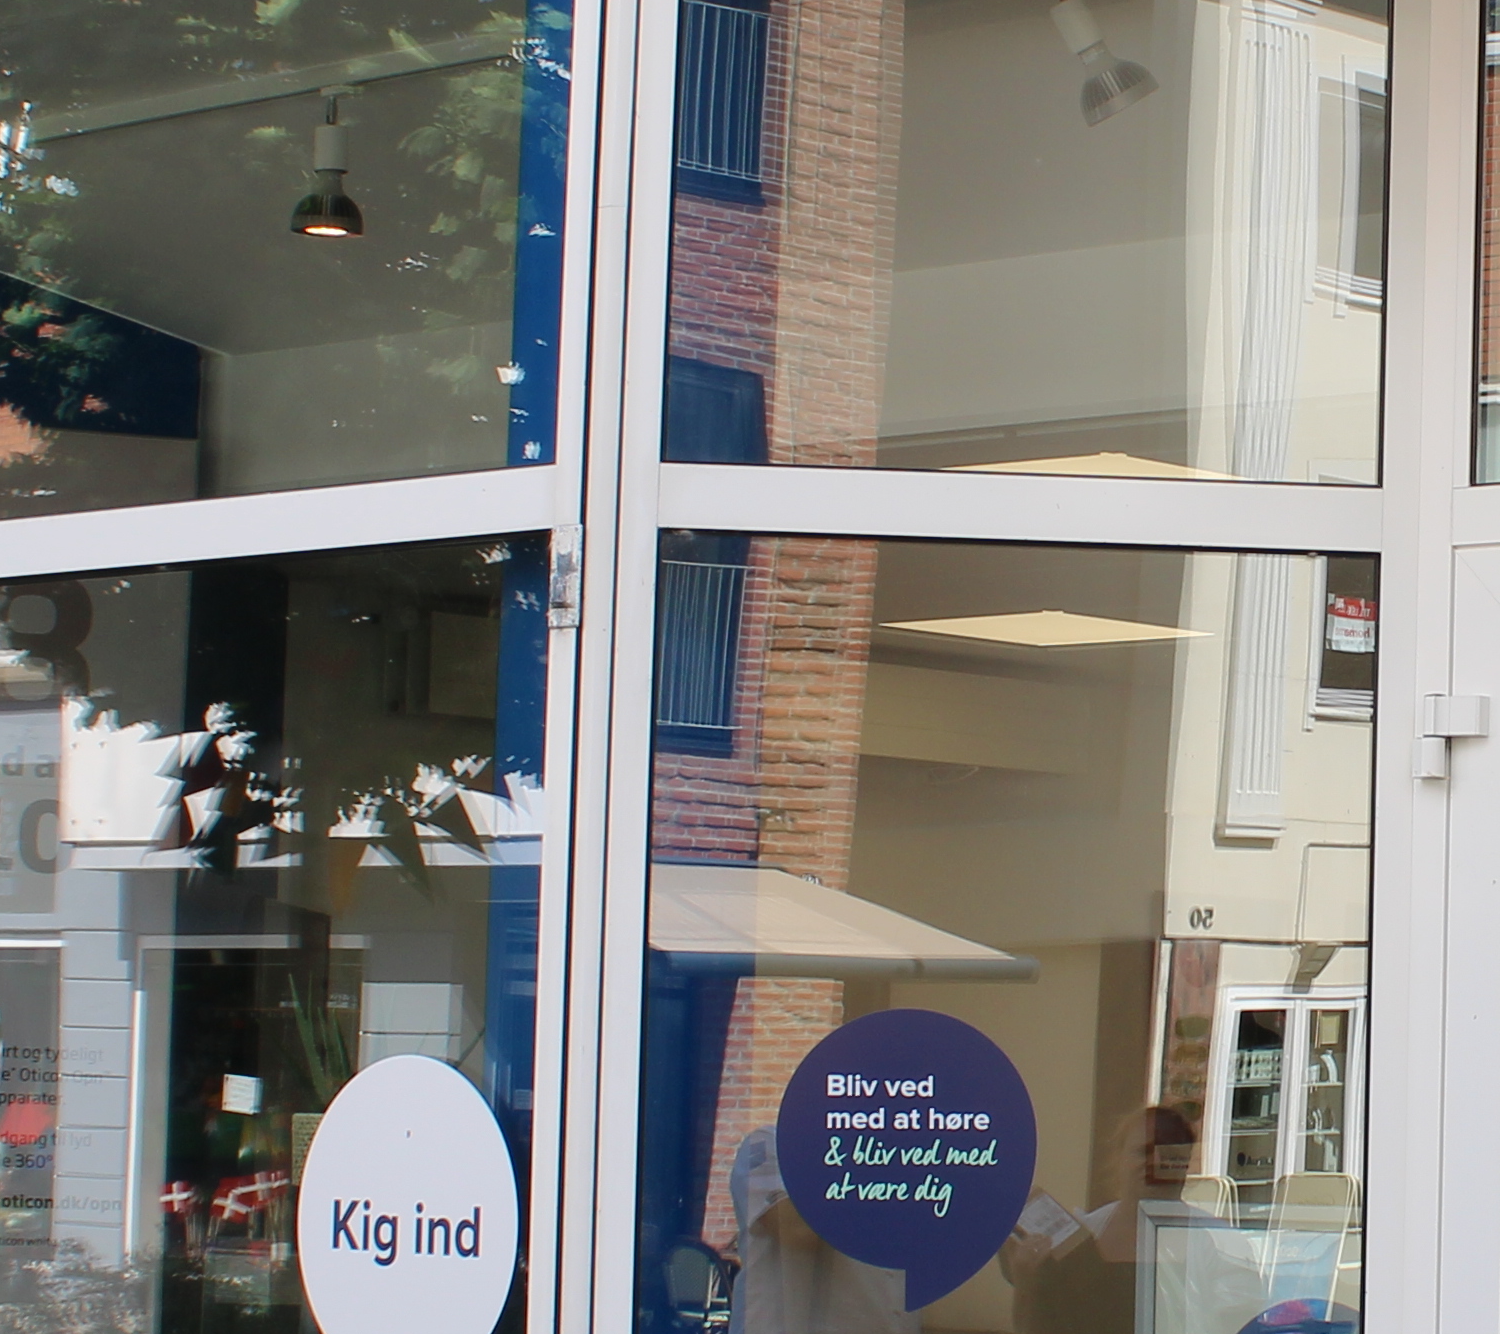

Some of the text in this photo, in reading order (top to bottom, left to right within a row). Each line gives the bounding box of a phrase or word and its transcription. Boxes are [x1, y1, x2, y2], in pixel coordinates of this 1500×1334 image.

[23, 1047, 41, 1063] og
[826, 1073, 935, 1098] Bliv ved
[826, 1107, 991, 1131] med at høre
[824, 1134, 999, 1166] & bliv ved med
[0, 1193, 123, 1213] oticon.dk/opn
[825, 1171, 953, 1218] at være dig
[330, 1198, 483, 1267] Kig ind
